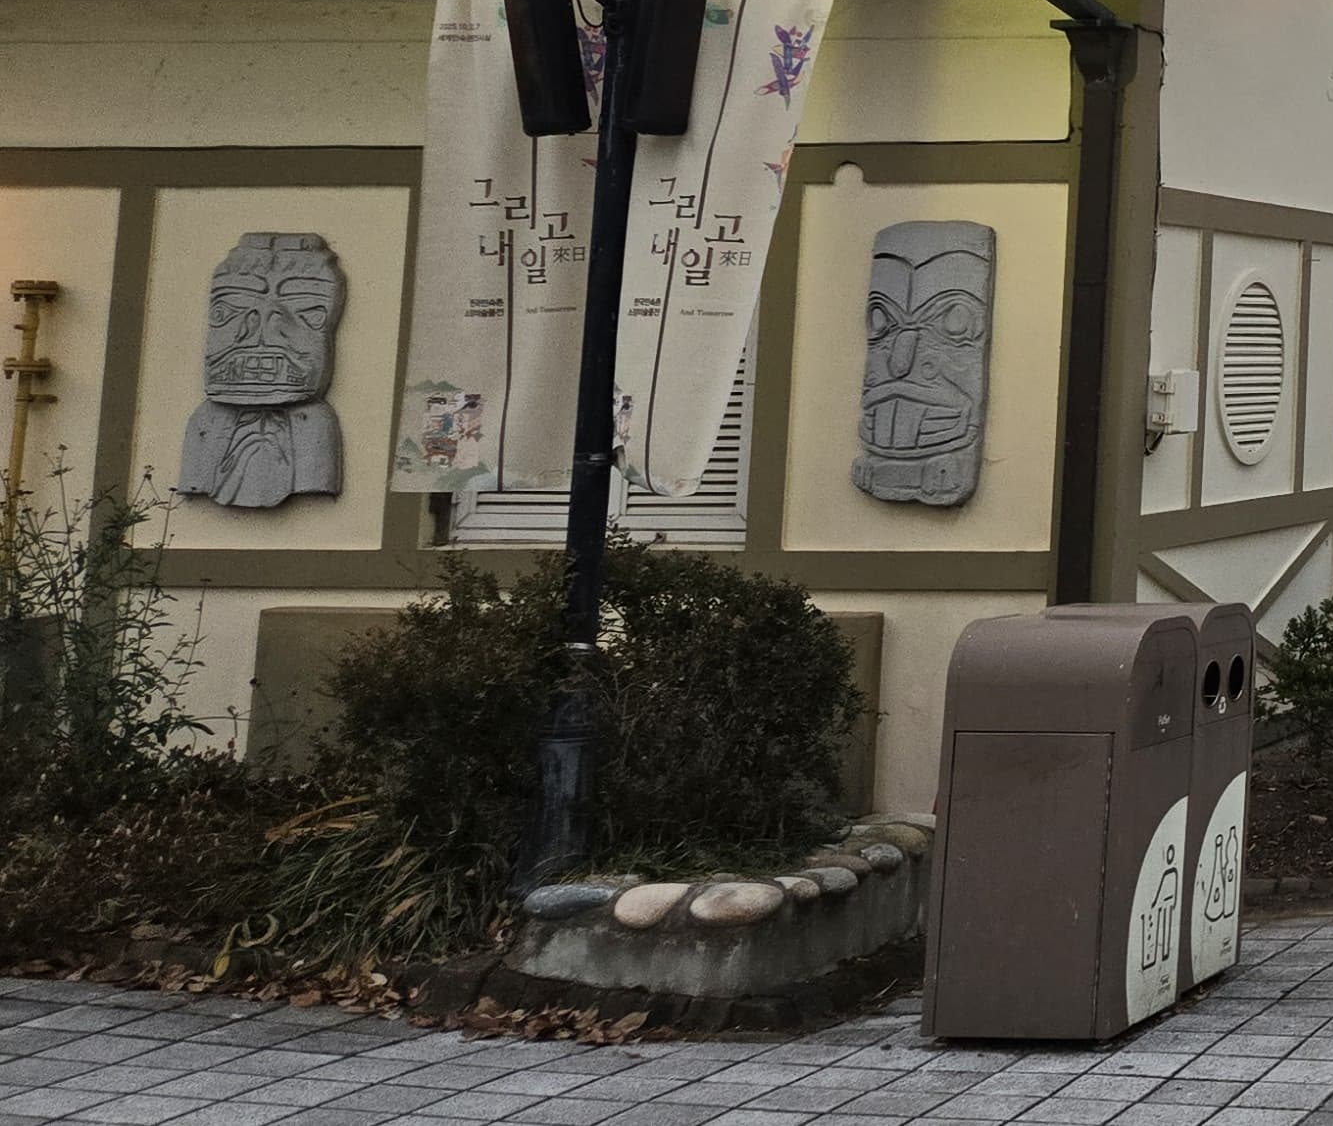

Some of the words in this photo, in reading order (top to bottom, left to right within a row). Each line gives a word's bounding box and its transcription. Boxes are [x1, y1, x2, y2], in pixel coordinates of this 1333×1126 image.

[469, 178, 575, 241] 그리고
[649, 176, 745, 244] 그리고
[479, 228, 547, 285] 내일
[552, 246, 586, 263] 來日
[651, 227, 714, 286] 내일
[719, 250, 752, 267] 來日
